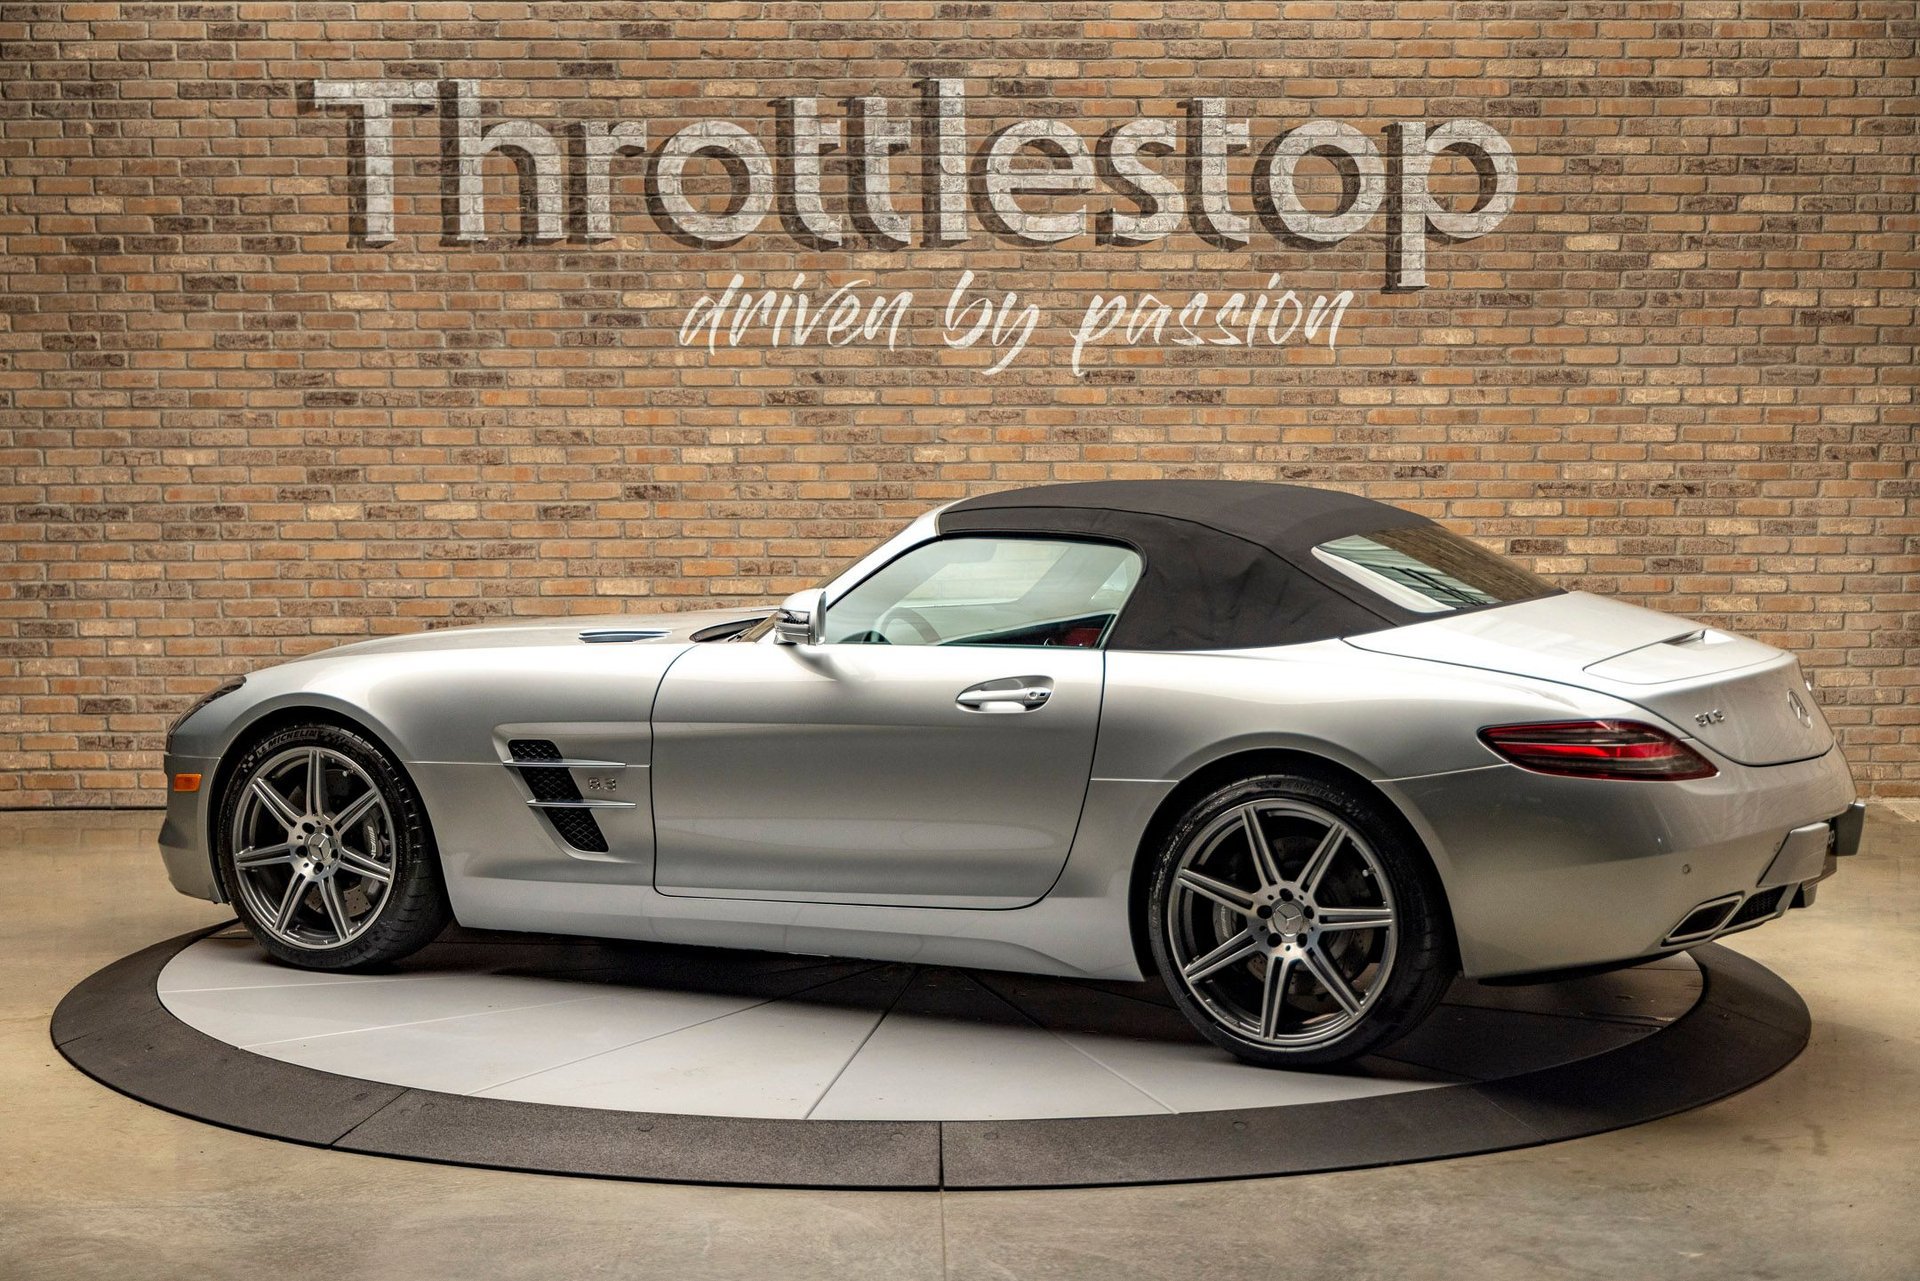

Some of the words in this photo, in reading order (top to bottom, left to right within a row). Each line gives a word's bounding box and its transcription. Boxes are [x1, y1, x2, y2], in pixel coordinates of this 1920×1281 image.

[312, 78, 1519, 289] Throttlestop
[677, 272, 914, 356] driven
[943, 270, 1040, 376] by
[1067, 272, 1354, 377] passion
[1694, 709, 1725, 727] SLS
